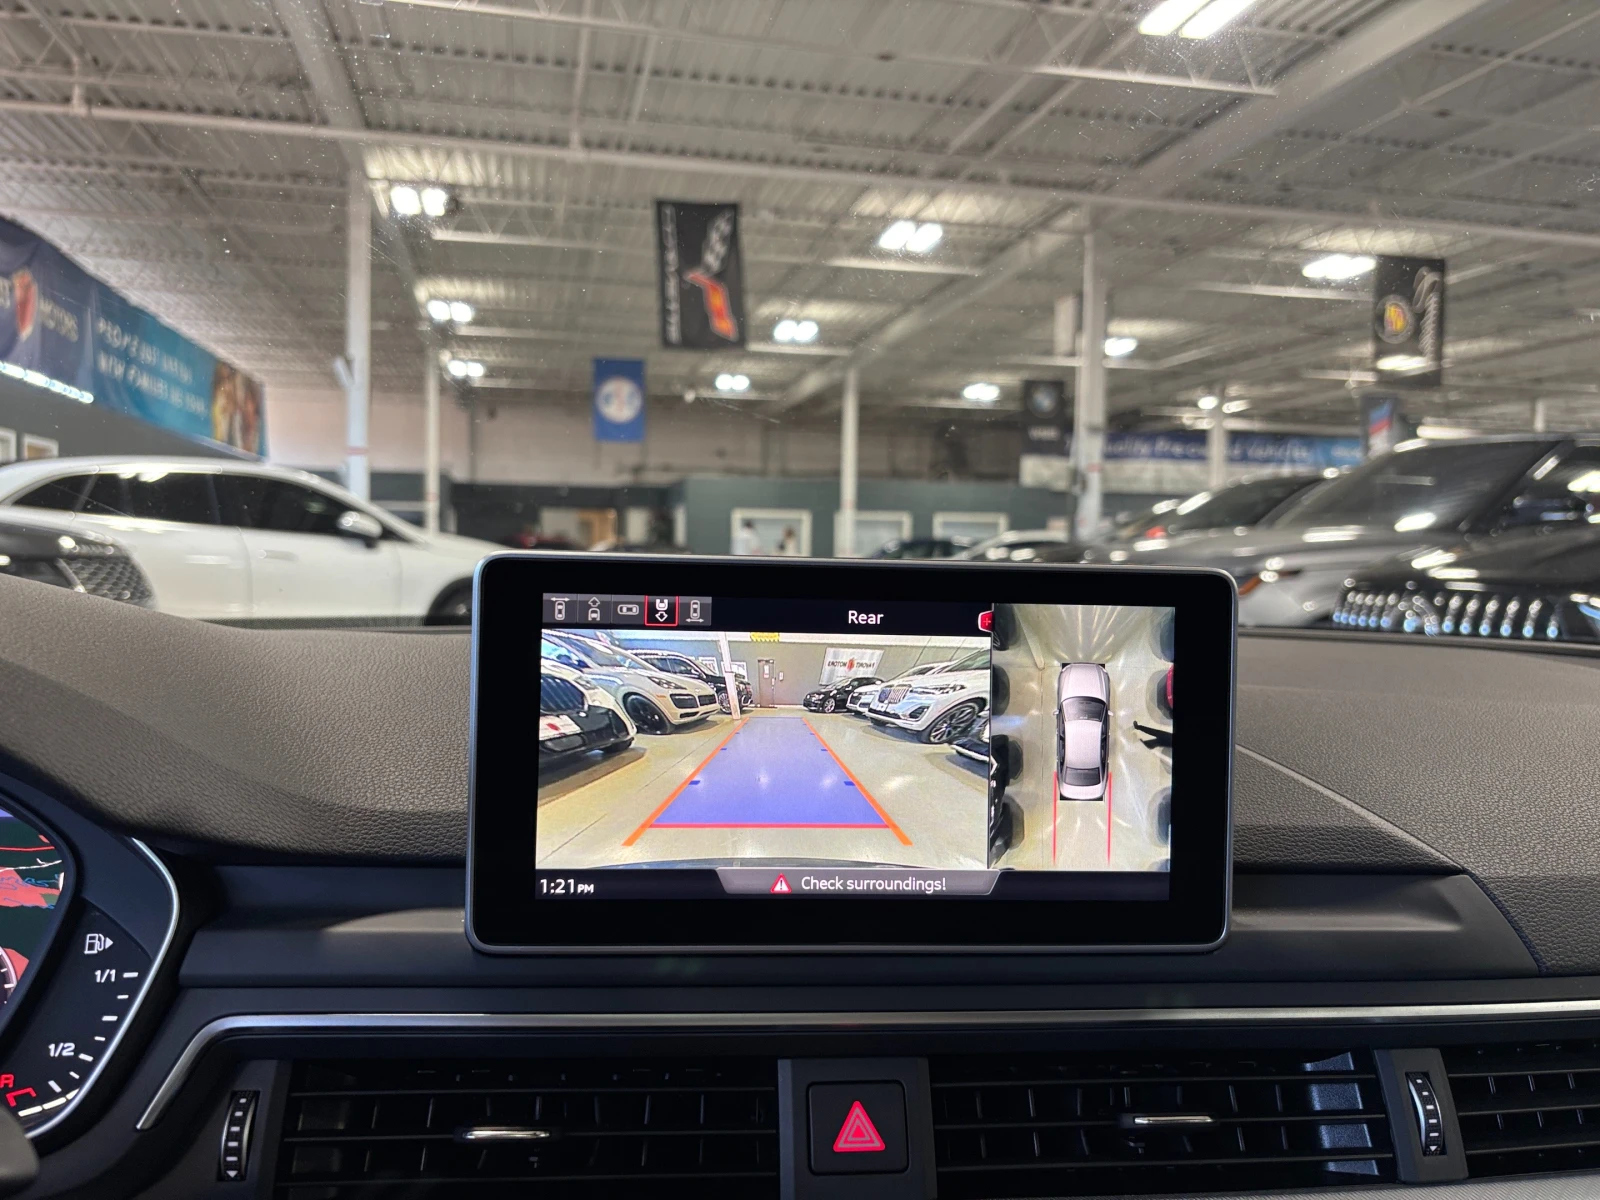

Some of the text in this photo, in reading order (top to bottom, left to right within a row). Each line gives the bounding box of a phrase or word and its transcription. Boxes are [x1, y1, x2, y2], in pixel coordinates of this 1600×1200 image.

[848, 609, 885, 625] Rear
[801, 876, 947, 894] Check surroundings!
[94, 968, 117, 984] 1/1
[47, 1042, 76, 1058] 1/2
